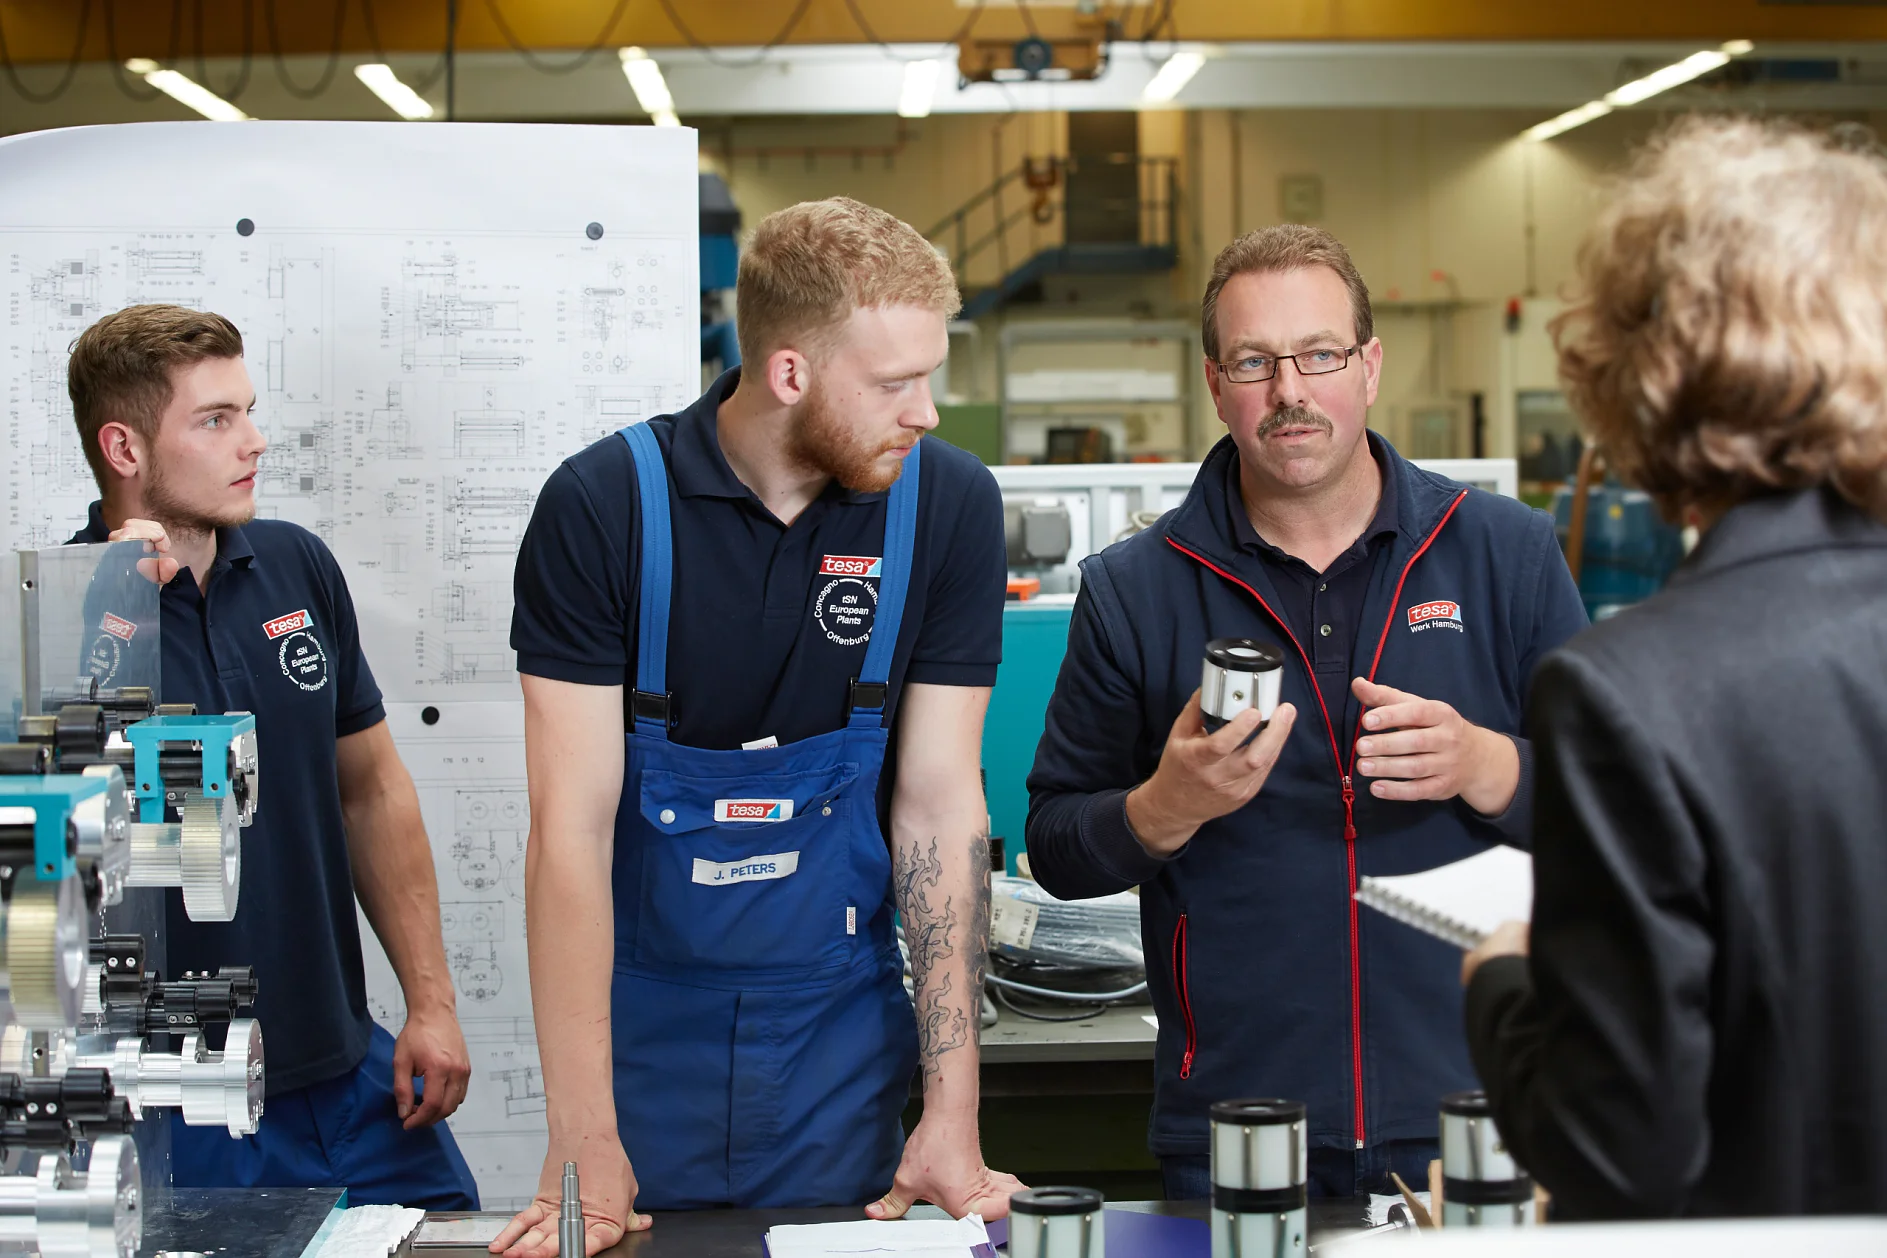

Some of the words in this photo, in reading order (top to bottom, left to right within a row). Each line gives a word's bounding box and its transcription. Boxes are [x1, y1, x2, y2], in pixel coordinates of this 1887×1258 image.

[824, 558, 865, 573] tesa
[814, 579, 839, 618] Concagno
[829, 604, 869, 615] European
[1411, 604, 1449, 619] tesa
[269, 614, 302, 634] tesa
[836, 615, 862, 625] Plants
[1410, 623, 1431, 633] Werk
[1432, 620, 1464, 633] Hamburg
[826, 631, 870, 645] Offenburg
[291, 654, 319, 668] European
[300, 663, 318, 675] Plants
[729, 804, 764, 816] tesa
[714, 871, 725, 880] J.
[730, 863, 776, 878] PETERS
